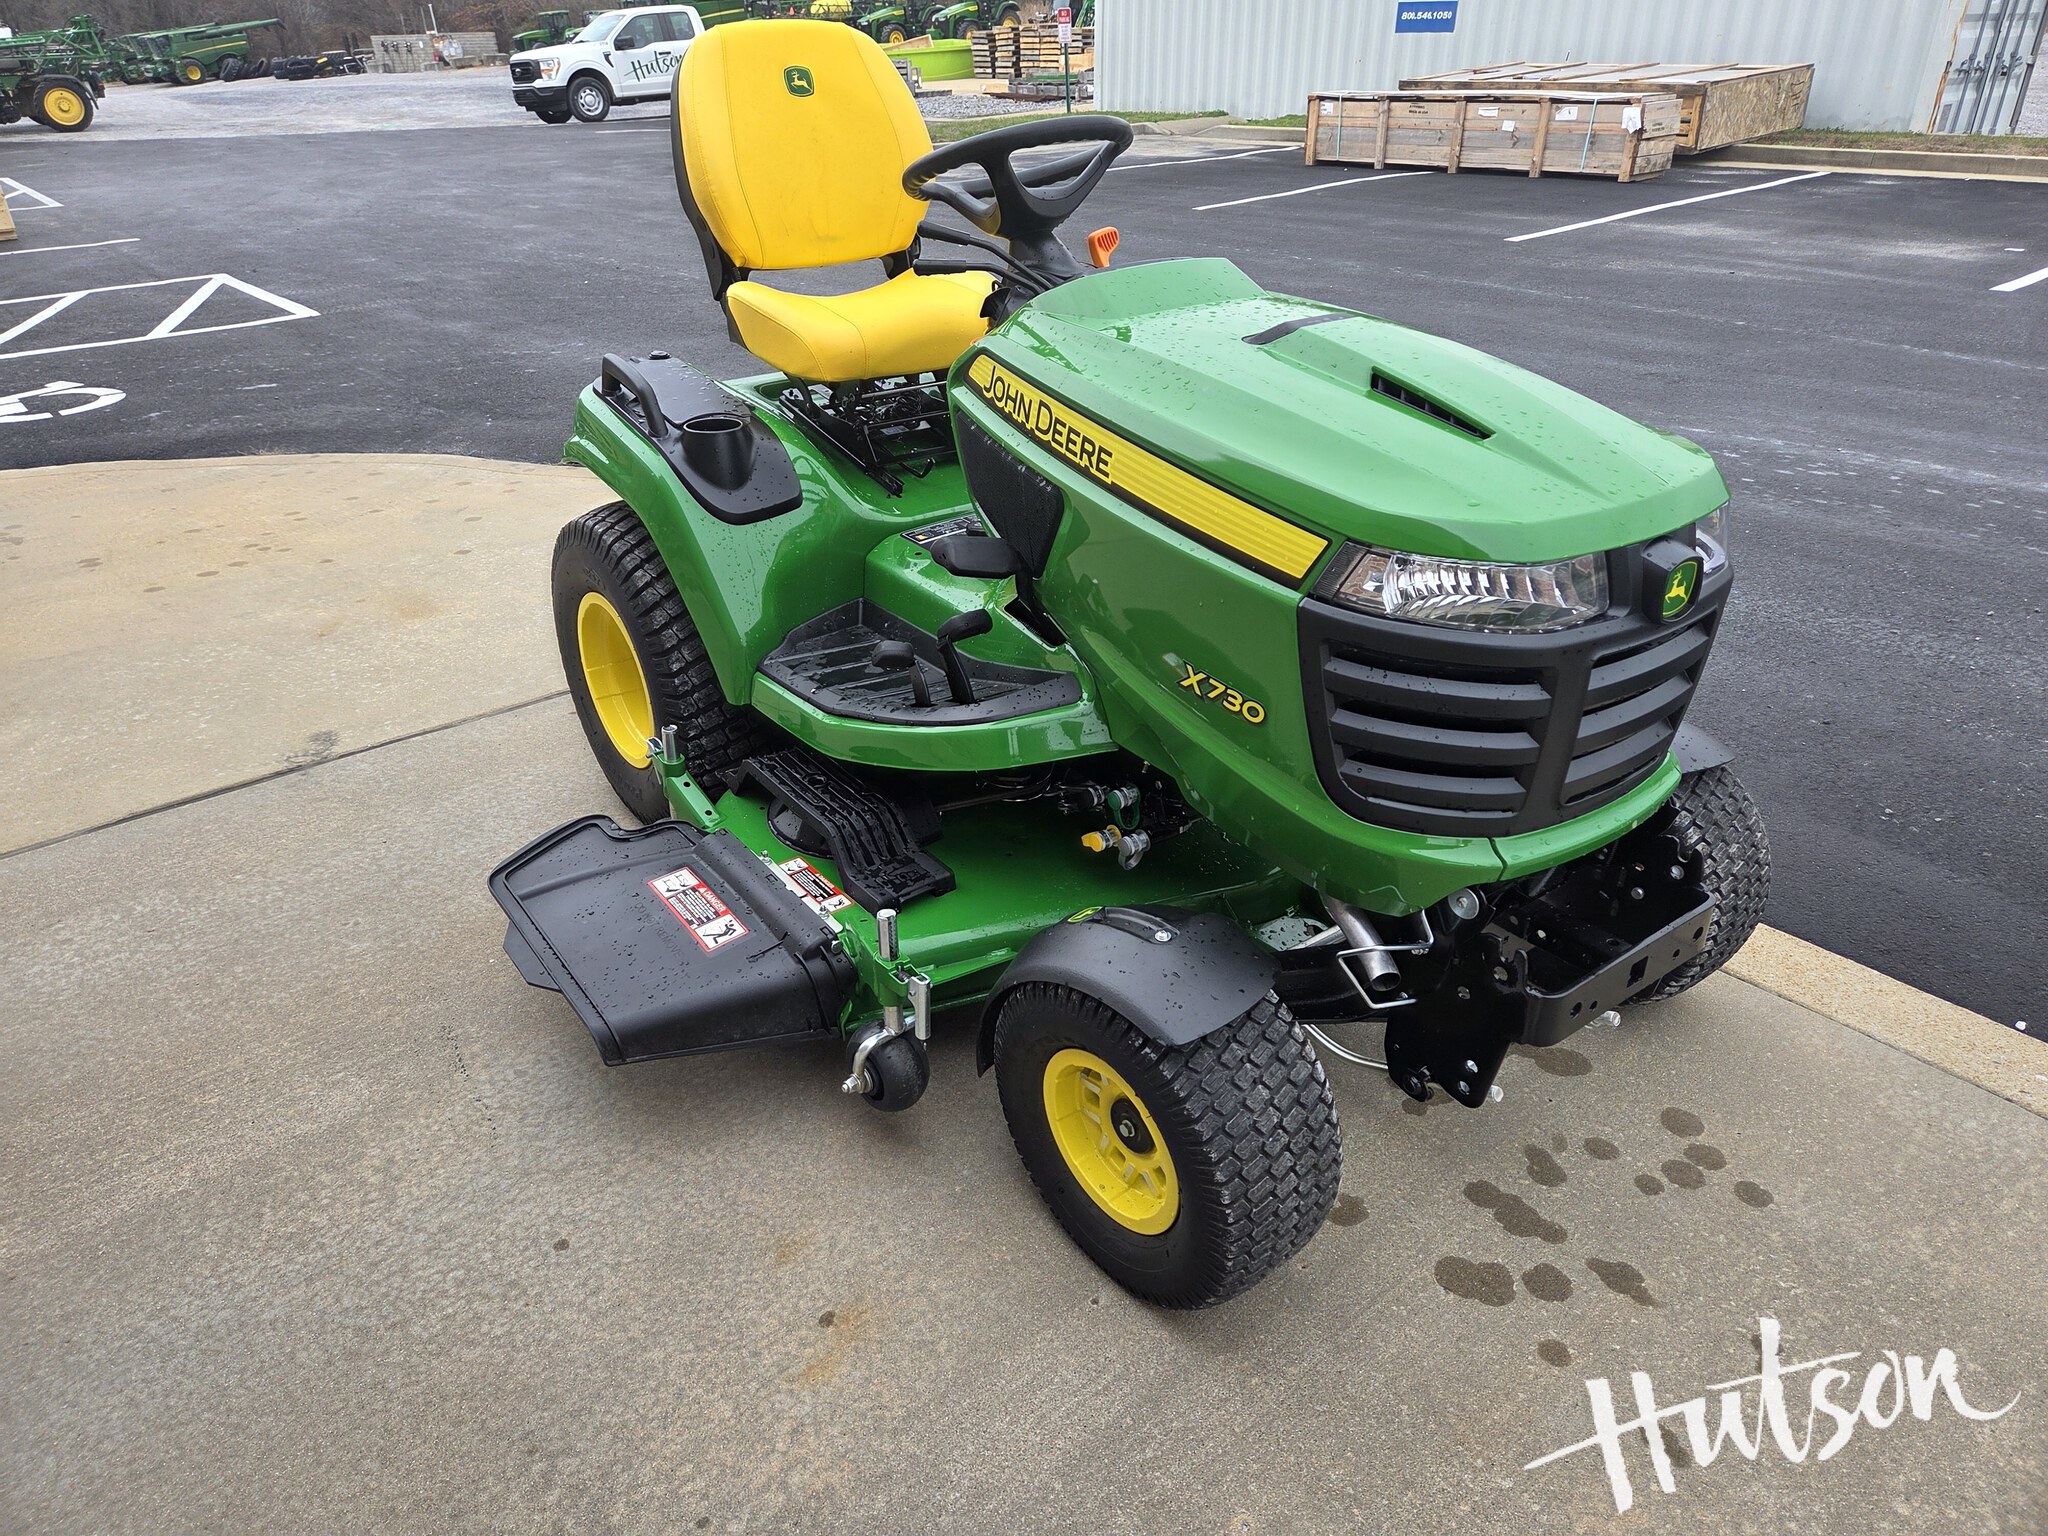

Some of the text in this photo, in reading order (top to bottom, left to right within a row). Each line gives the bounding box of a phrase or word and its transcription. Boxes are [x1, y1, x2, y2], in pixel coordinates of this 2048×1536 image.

[982, 364, 1113, 480] JOHN DEERE
[1178, 662, 1266, 725] X730
[703, 891, 726, 912] DANGER
